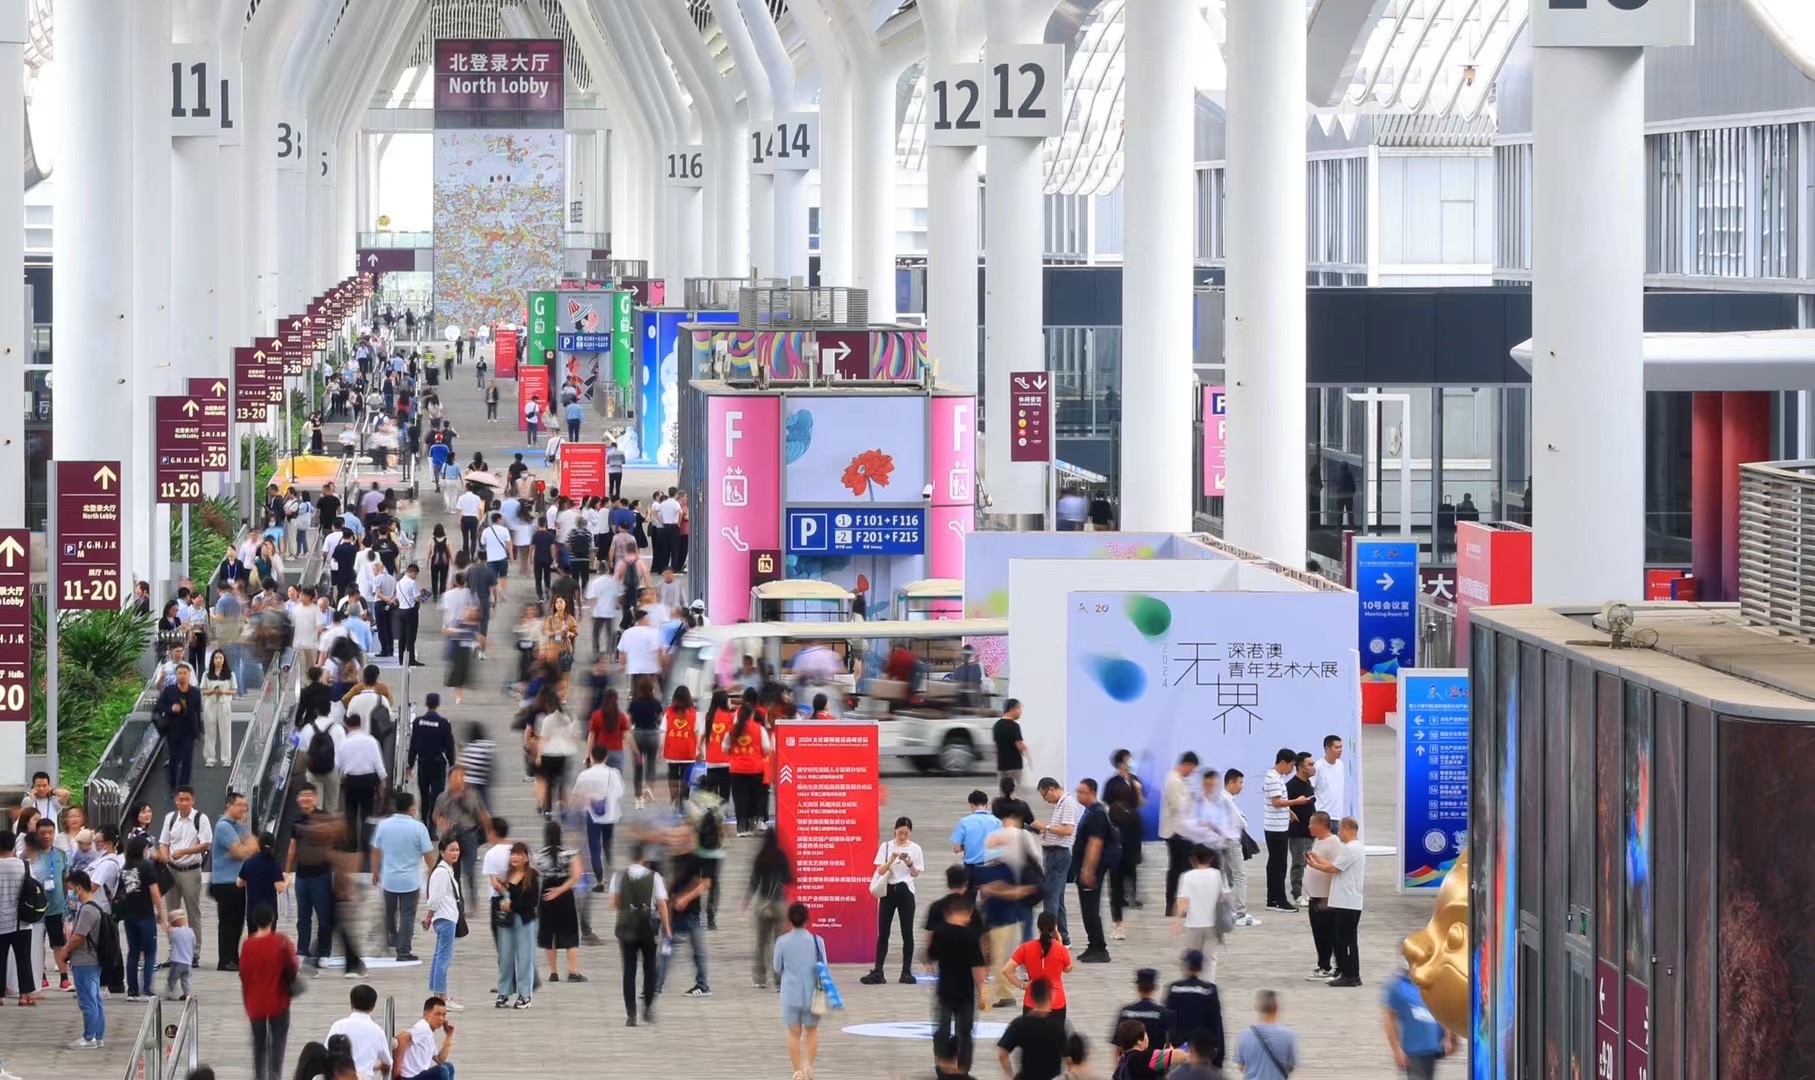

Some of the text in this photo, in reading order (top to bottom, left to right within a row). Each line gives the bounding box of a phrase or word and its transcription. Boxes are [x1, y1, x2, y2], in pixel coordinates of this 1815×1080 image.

[449, 53, 550, 72] 北登录大厅
[172, 62, 210, 117] 11
[449, 77, 549, 98] North Lobby
[994, 63, 1046, 118] 12
[933, 80, 980, 130] 12
[777, 124, 810, 158] 14
[534, 297, 545, 316] G
[620, 296, 630, 314] G
[563, 337, 571, 348] P
[237, 408, 265, 419] 13-20
[725, 411, 743, 457] F
[953, 405, 967, 451] F
[161, 482, 200, 498] 11-20
[83, 504, 116, 513] 北登录大厅
[99, 513, 116, 521] Lobby
[801, 518, 818, 546] P
[64, 580, 117, 601] 11-20
[1362, 601, 1409, 610] 10号会议室
[1228, 643, 1283, 659] 深港澳
[1229, 662, 1338, 678] 青年艺术大展
